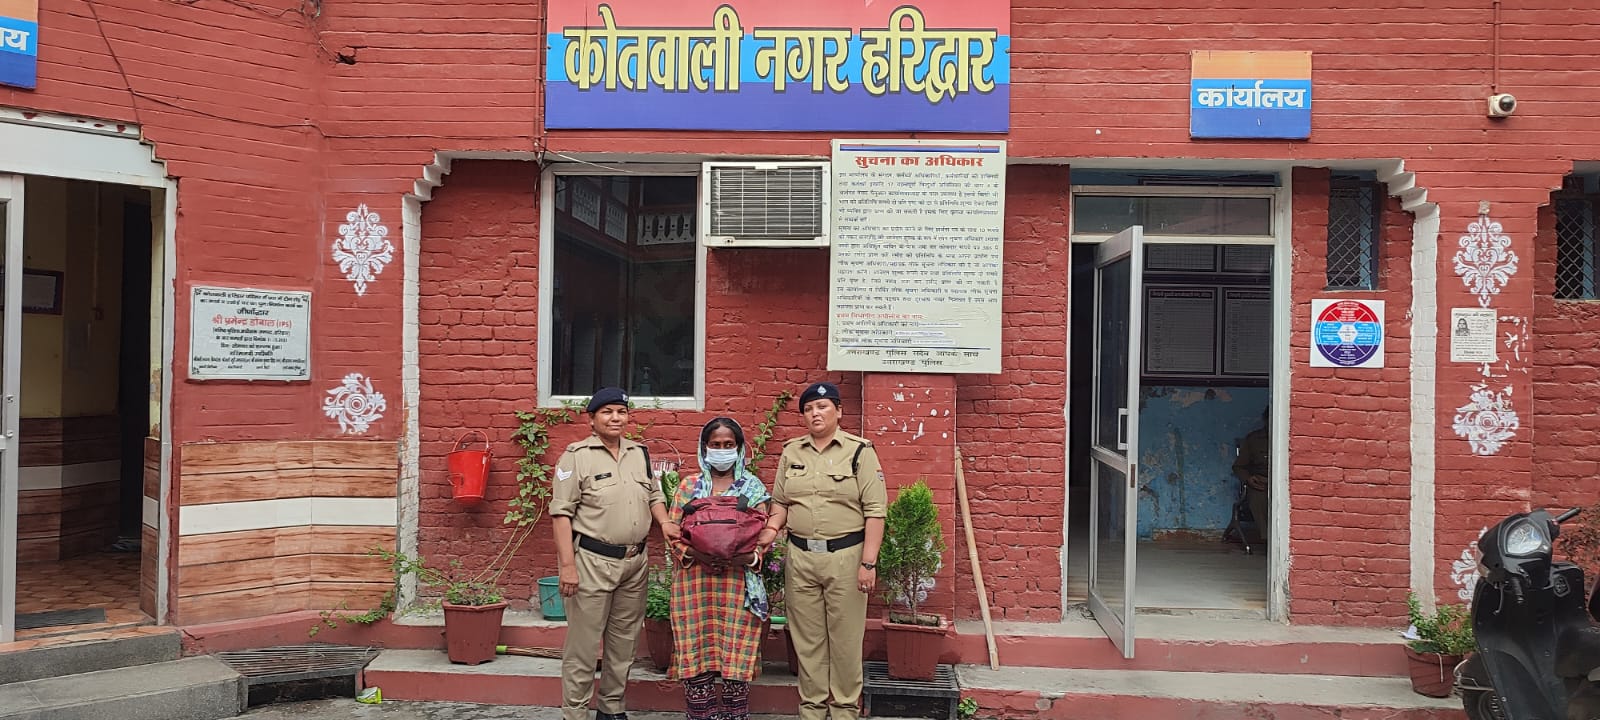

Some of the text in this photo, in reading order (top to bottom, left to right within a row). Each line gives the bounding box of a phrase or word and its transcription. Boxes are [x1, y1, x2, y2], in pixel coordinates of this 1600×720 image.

[564, 5, 997, 103] कोतवाली नगर हरिद्वार
[1198, 80, 1306, 109] कार्यालय
[900, 157, 920, 166] का
[925, 155, 984, 166] अधिकार
